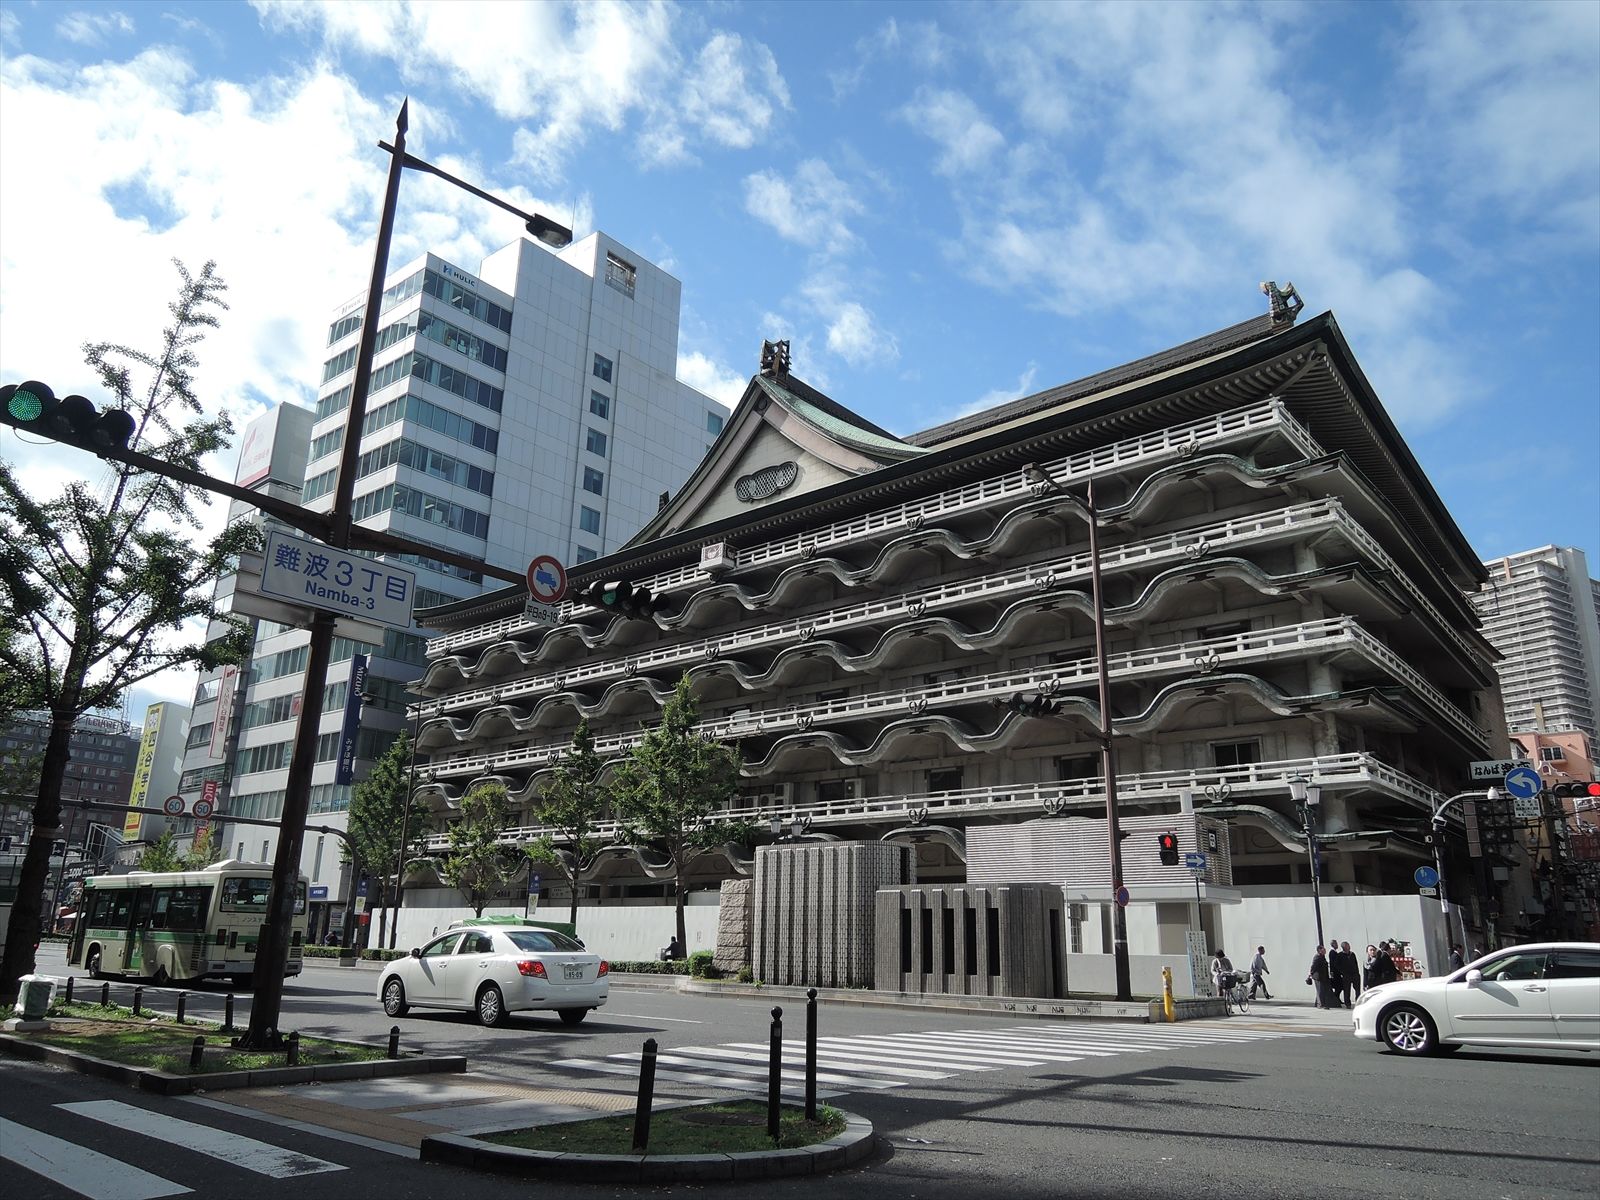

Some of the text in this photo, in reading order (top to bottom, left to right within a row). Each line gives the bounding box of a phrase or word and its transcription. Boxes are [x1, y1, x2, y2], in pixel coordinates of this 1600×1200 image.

[453, 271, 475, 287] HULIC
[274, 543, 407, 602] 難波3丁目
[304, 581, 375, 611] Namba-3
[168, 801, 180, 811] 60
[197, 804, 209, 814] 50
